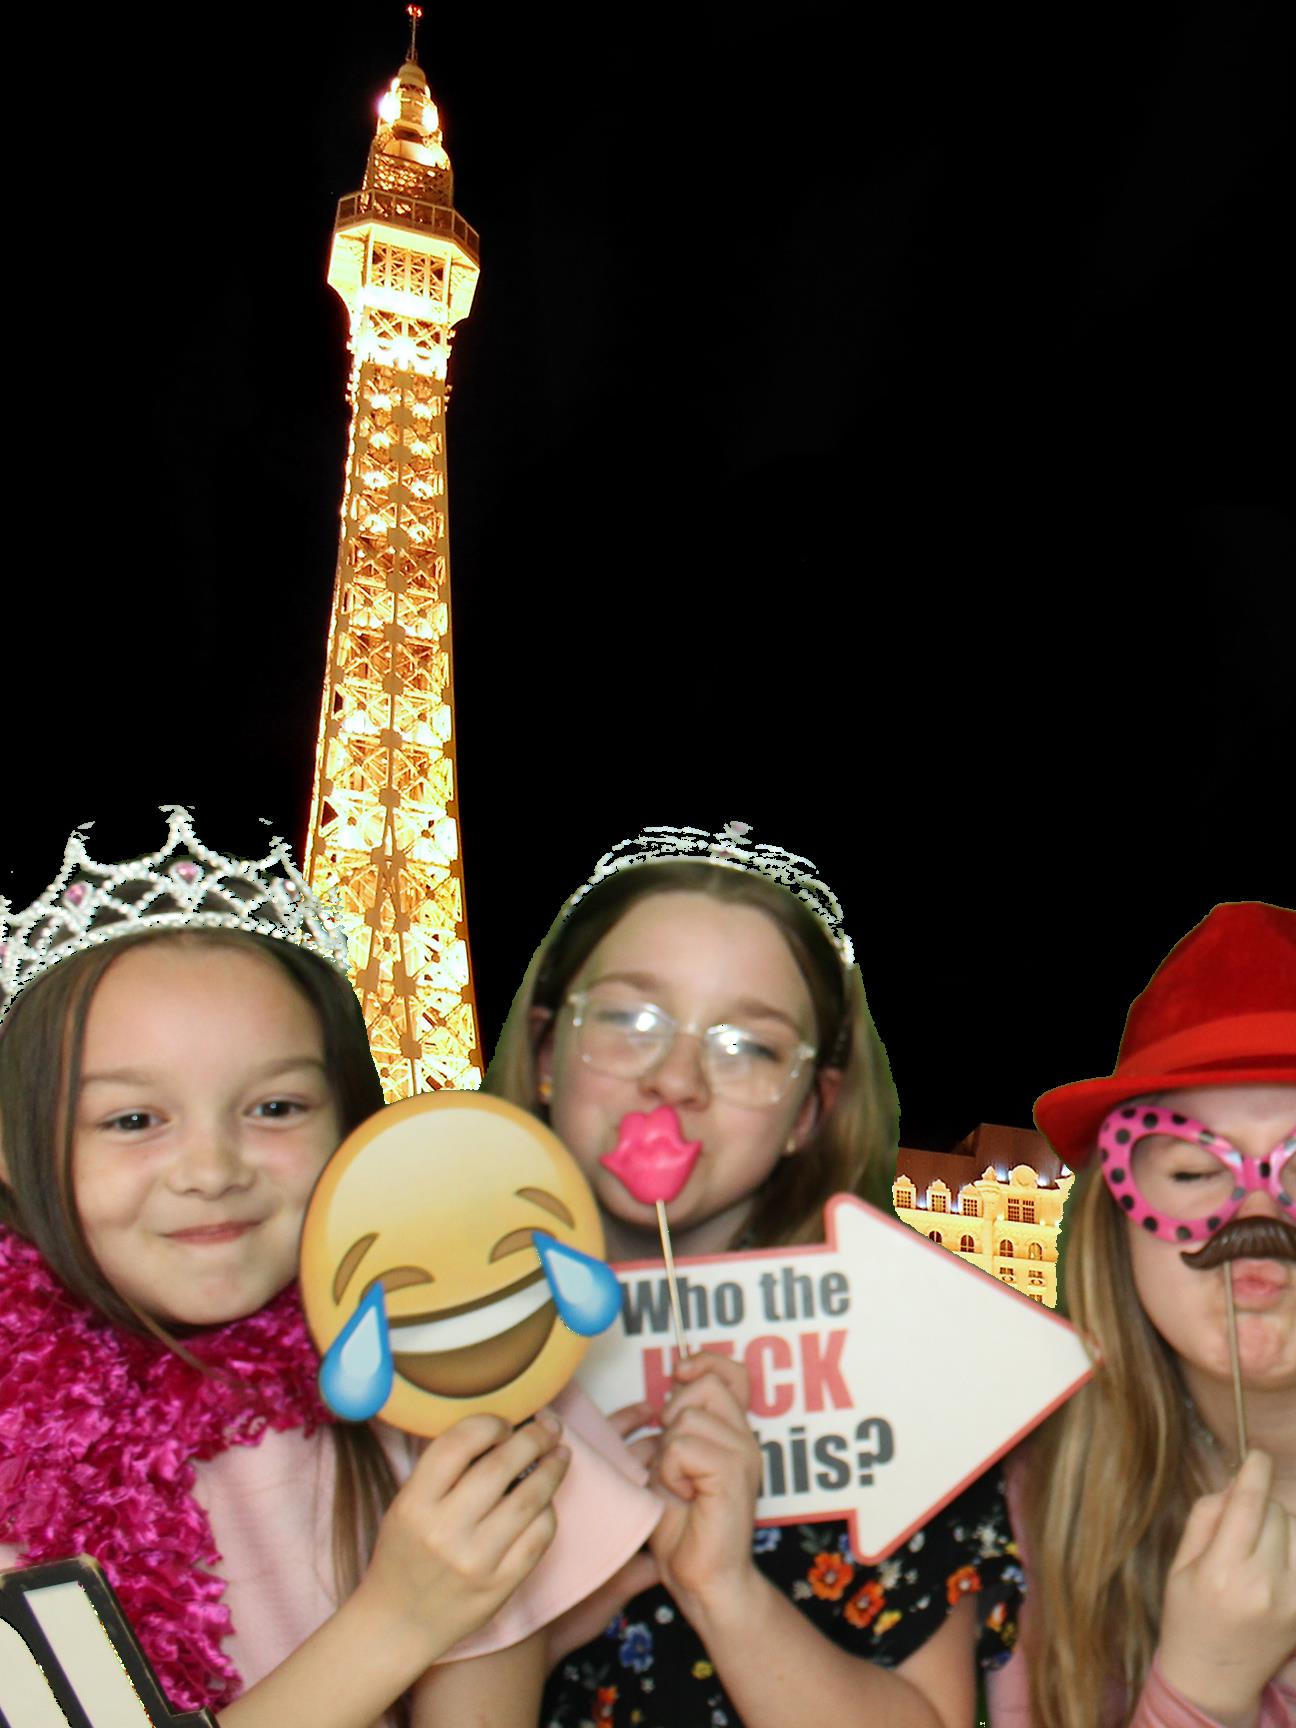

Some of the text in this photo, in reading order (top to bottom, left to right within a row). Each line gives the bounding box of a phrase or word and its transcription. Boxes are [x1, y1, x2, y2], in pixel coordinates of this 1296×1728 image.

[620, 1267, 851, 1337] Who the
[642, 1329, 854, 1428] HCK
[755, 1417, 895, 1498] his?
